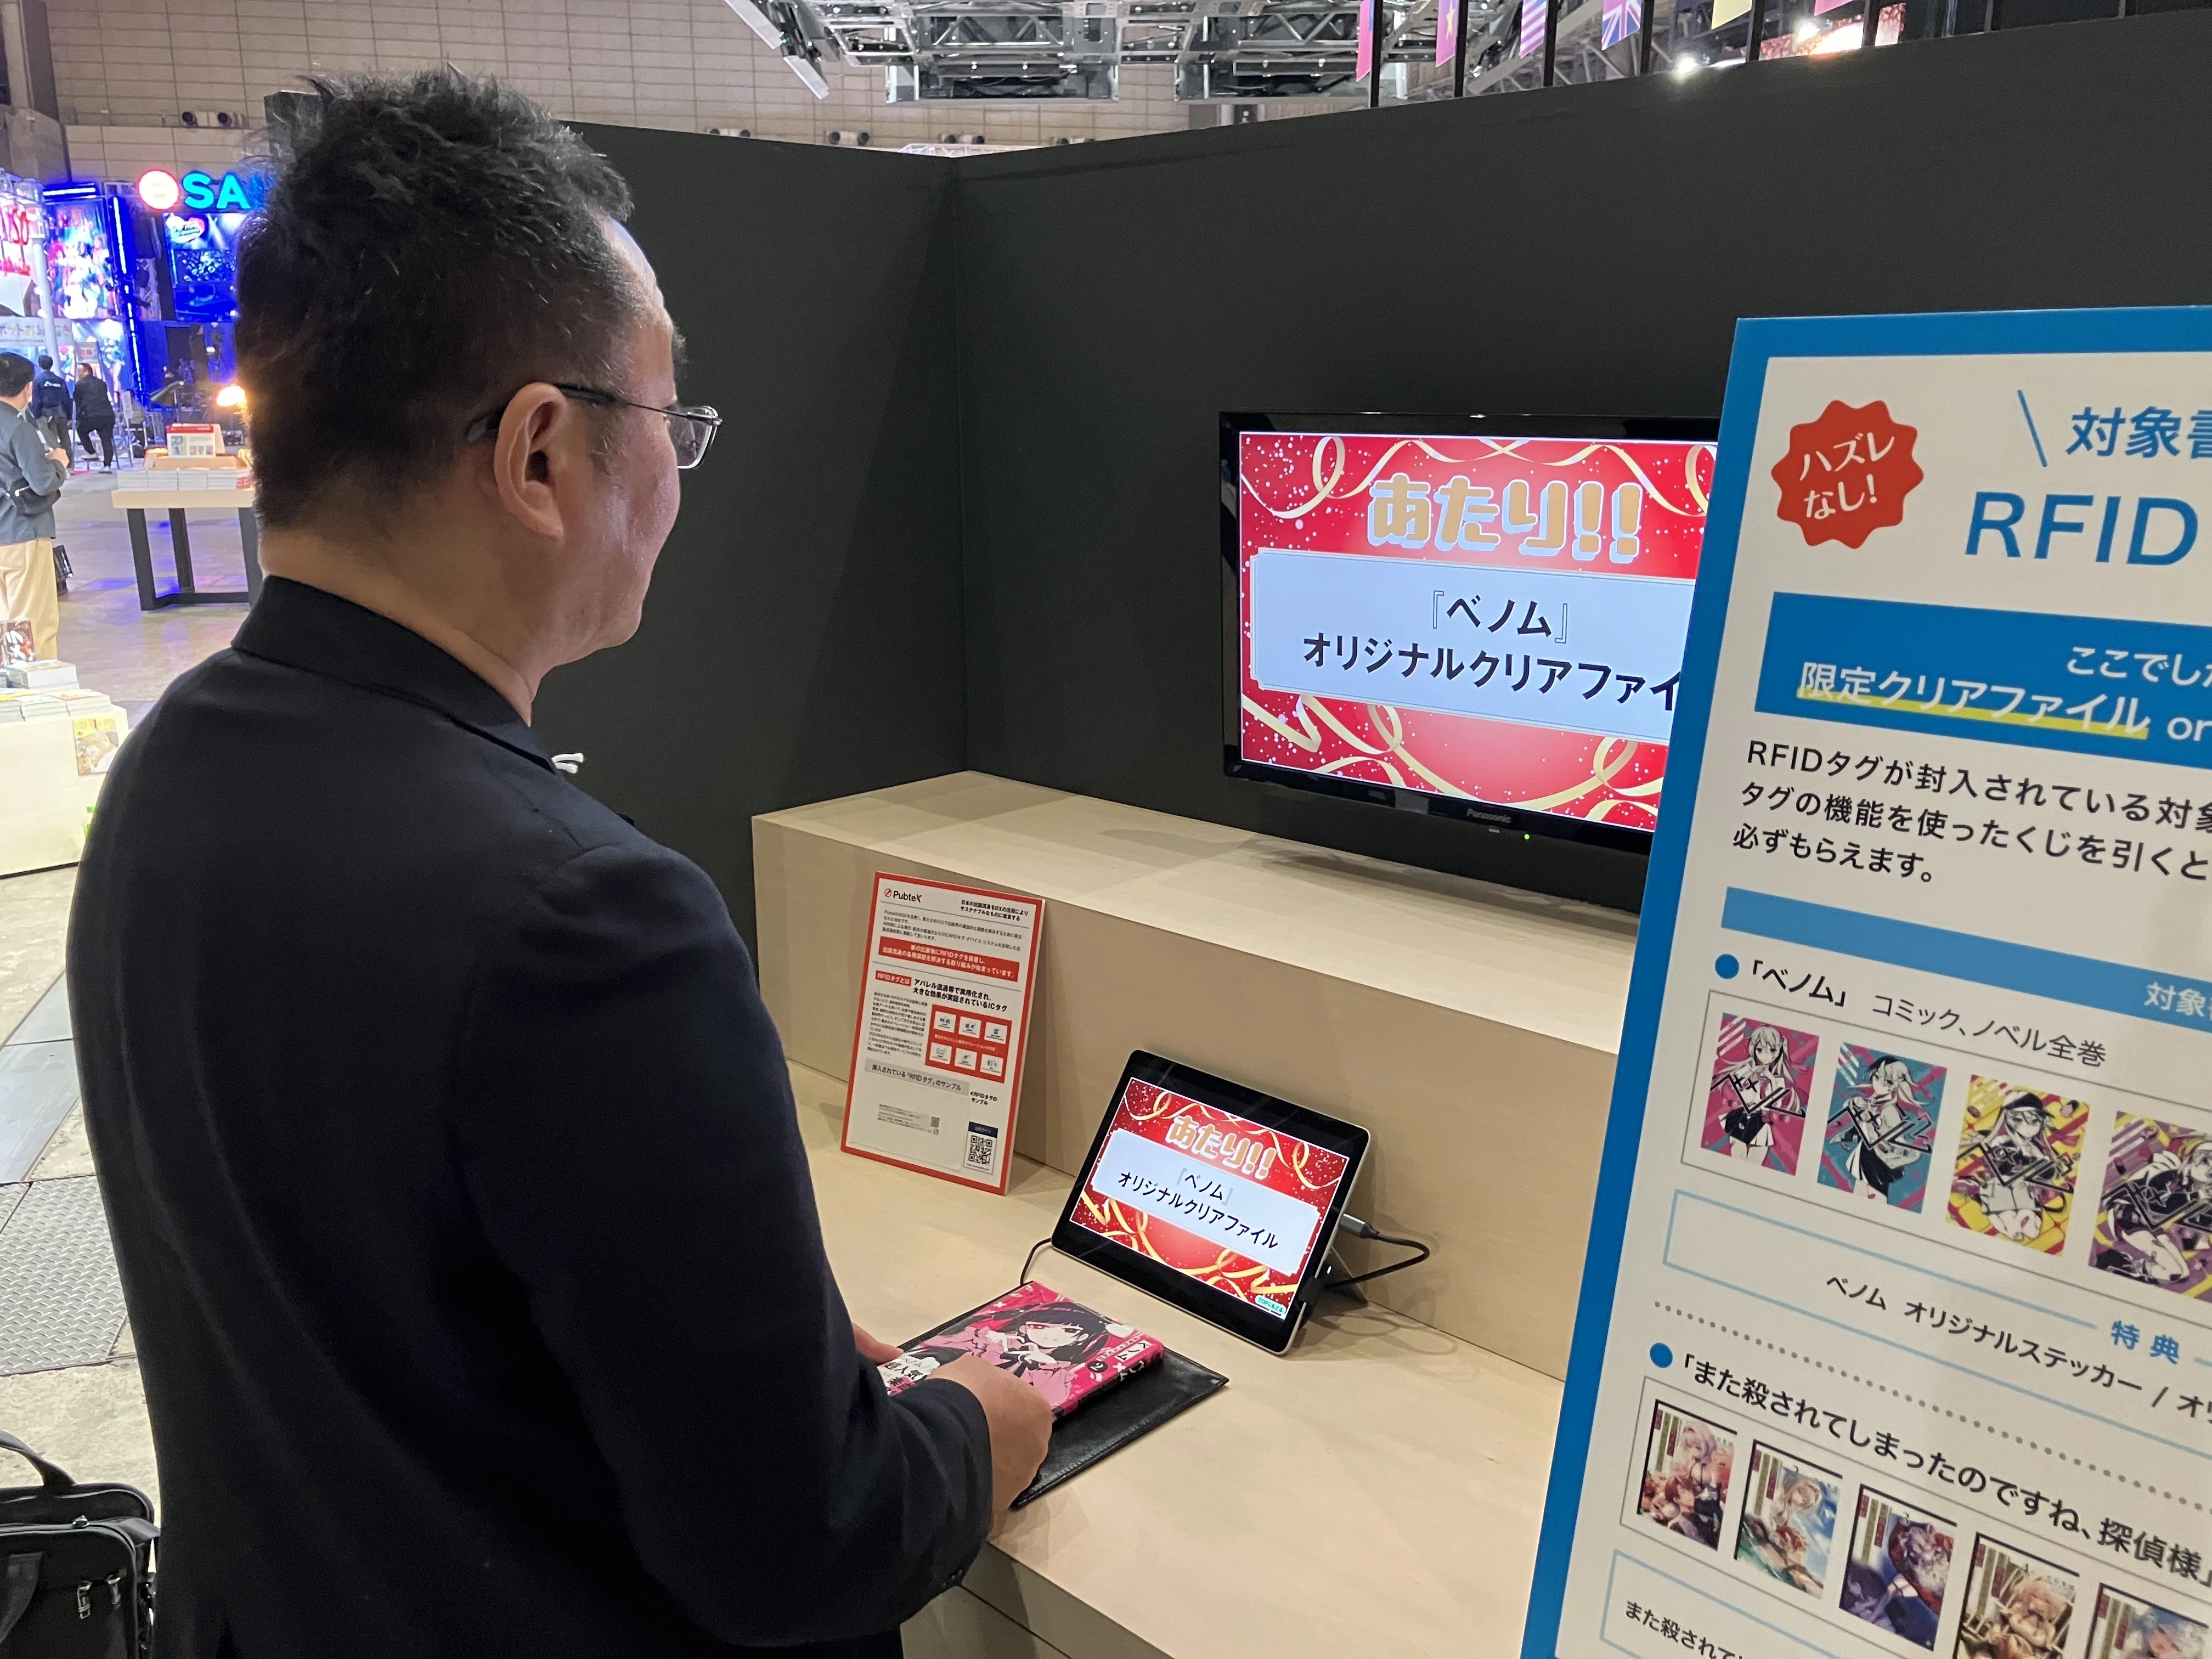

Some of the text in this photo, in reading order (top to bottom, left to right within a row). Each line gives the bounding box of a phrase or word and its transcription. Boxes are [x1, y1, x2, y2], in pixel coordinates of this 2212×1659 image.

[1798, 432, 1895, 480] ハズレ
[1367, 473, 1643, 563] あたり!!
[1804, 481, 1878, 520] なし!
[1965, 492, 2199, 565] RFID
[1432, 590, 1569, 644] 『ベノム』
[2067, 646, 2212, 687] ここでし
[1799, 661, 2151, 735] 限定クリアファイル
[1466, 808, 1512, 824] Panasonic
[1741, 783, 2209, 881] タグの機能を使ったくじを引くと
[1733, 826, 1935, 883] 必ずもらえます。
[892, 890, 922, 903] PubteX
[1751, 960, 1847, 1008] 「ベノム」
[1872, 994, 2106, 1068] コミック、ノベル全巻
[2143, 981, 2212, 1021] 対象
[1119, 1171, 1279, 1250] オリジナルクリアファイル
[1176, 1167, 1233, 1206] 『ベノム』
[1826, 1274, 1887, 1312] ベノム
[1905, 1301, 2142, 1392] オリジナルステッカー
[1090, 1362, 1104, 1372] 2
[1681, 1352, 2212, 1588] 「また殺されてしまったのですね、探偵様」
